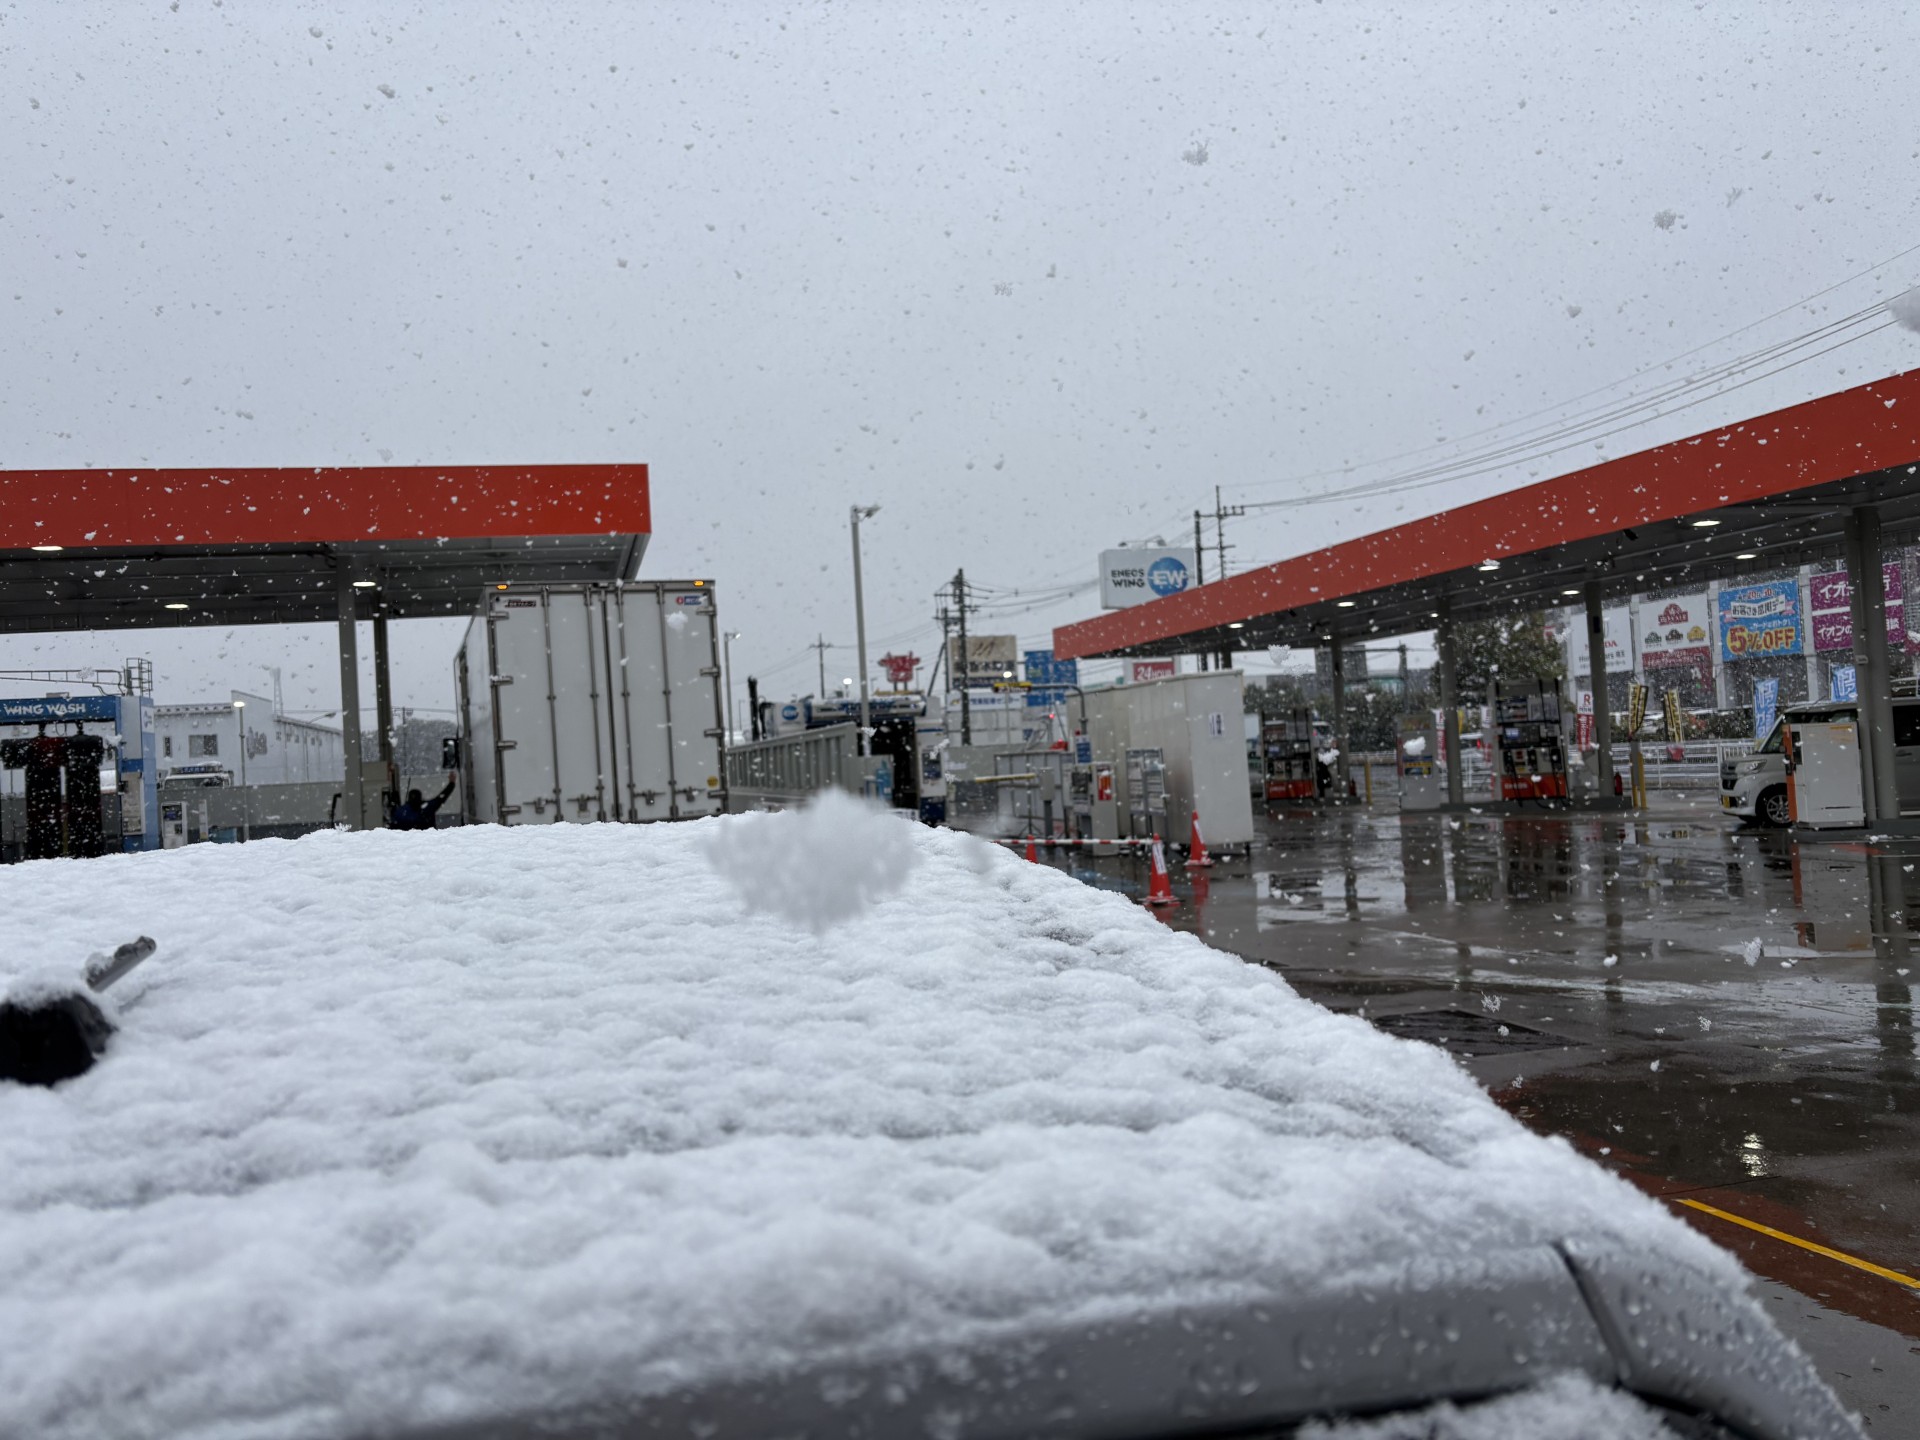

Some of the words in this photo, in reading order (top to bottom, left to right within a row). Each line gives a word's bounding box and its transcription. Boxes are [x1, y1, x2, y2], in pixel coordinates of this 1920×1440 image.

[1112, 579, 1145, 588] WING
[4, 704, 44, 716] WING
[46, 703, 86, 714] WASH
